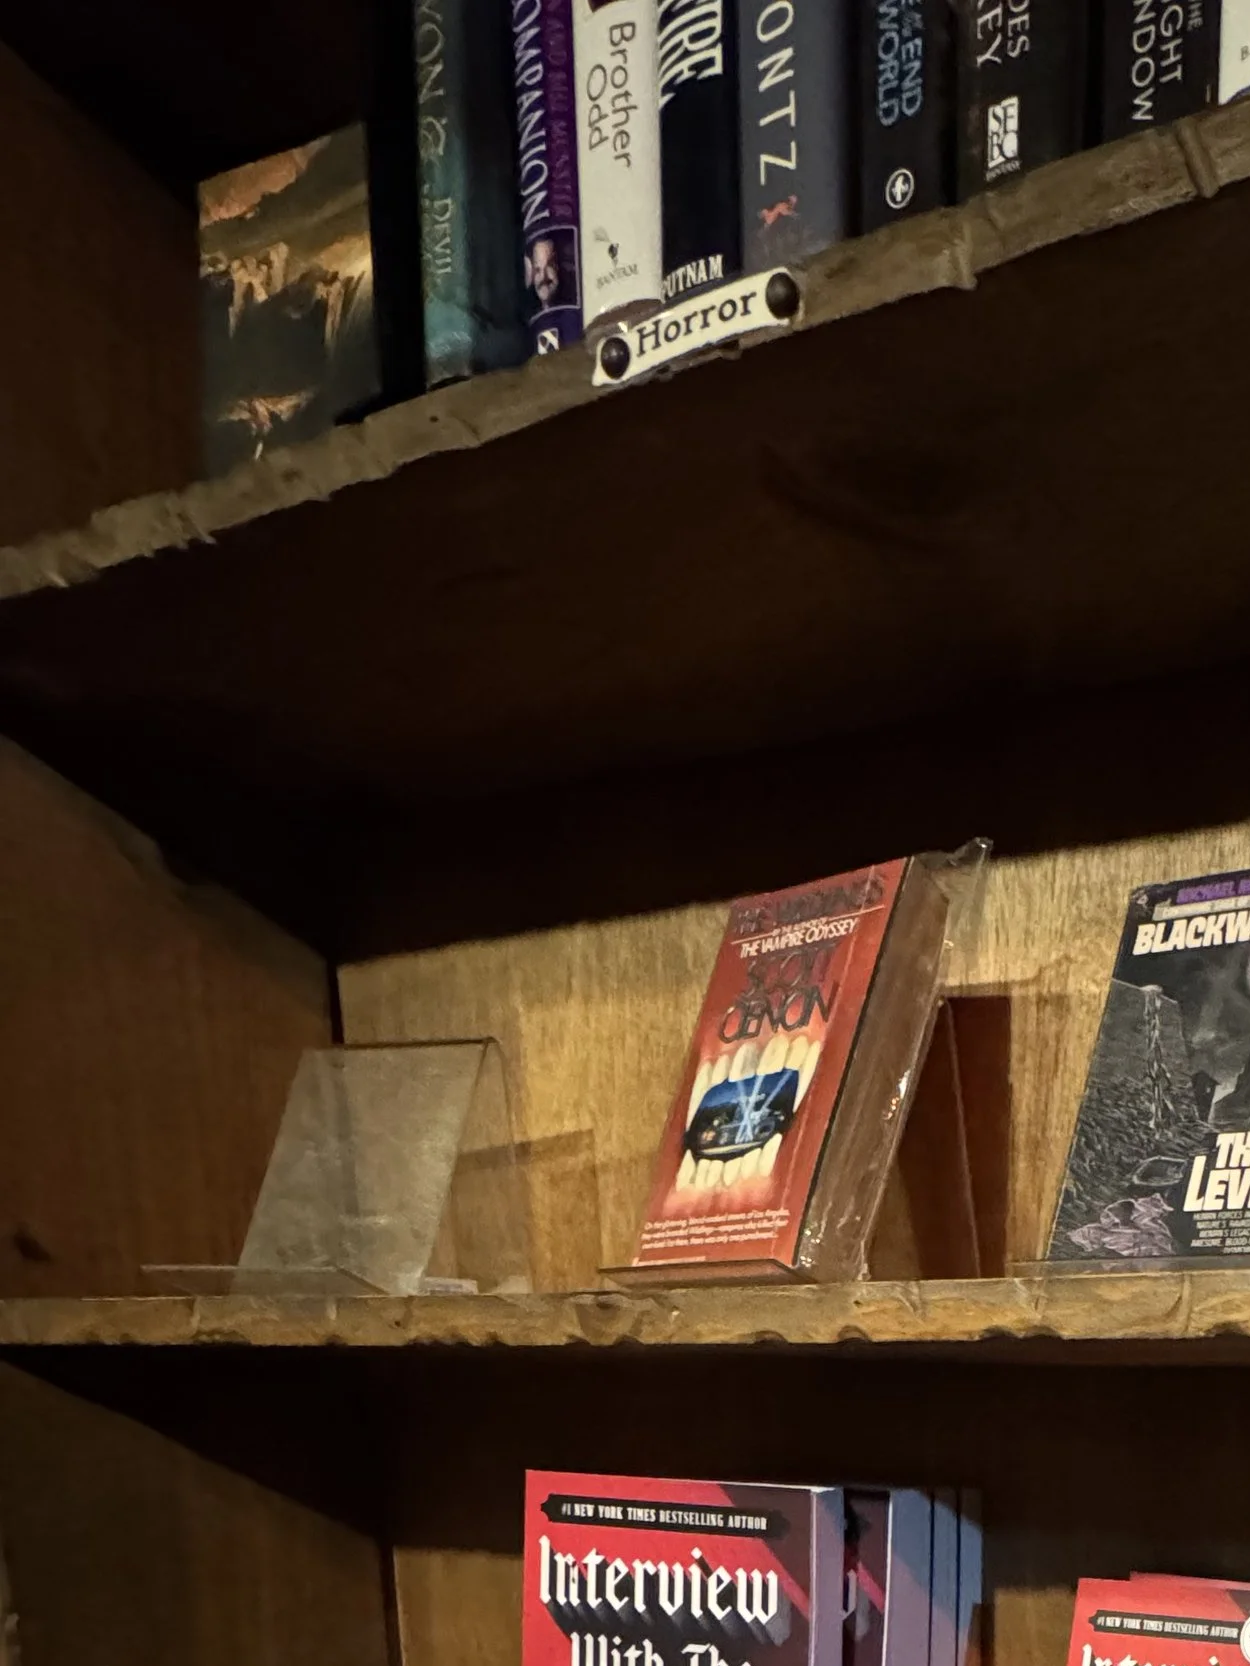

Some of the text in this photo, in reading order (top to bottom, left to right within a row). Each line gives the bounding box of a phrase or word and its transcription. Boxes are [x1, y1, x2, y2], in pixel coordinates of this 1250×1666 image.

[901, 37, 923, 116] END
[1160, 0, 1183, 83] GHT
[587, 64, 609, 151] Odd
[609, 21, 638, 169] Brother
[636, 292, 757, 357] Horror
[574, 1503, 595, 1518] NEW
[598, 1504, 624, 1521] YORK
[627, 1507, 656, 1522] TIMES
[659, 1508, 724, 1527] BESTSELLING
[727, 1513, 768, 1531] AUTHOR
[538, 1534, 778, 1625] Interview
[1105, 1616, 1121, 1628] NEW
[1123, 1618, 1142, 1631] YORK
[1143, 1619, 1163, 1632] TIMES
[1164, 1621, 1209, 1636] BESTSELLING
[1209, 1625, 1239, 1639] AUTHOR
